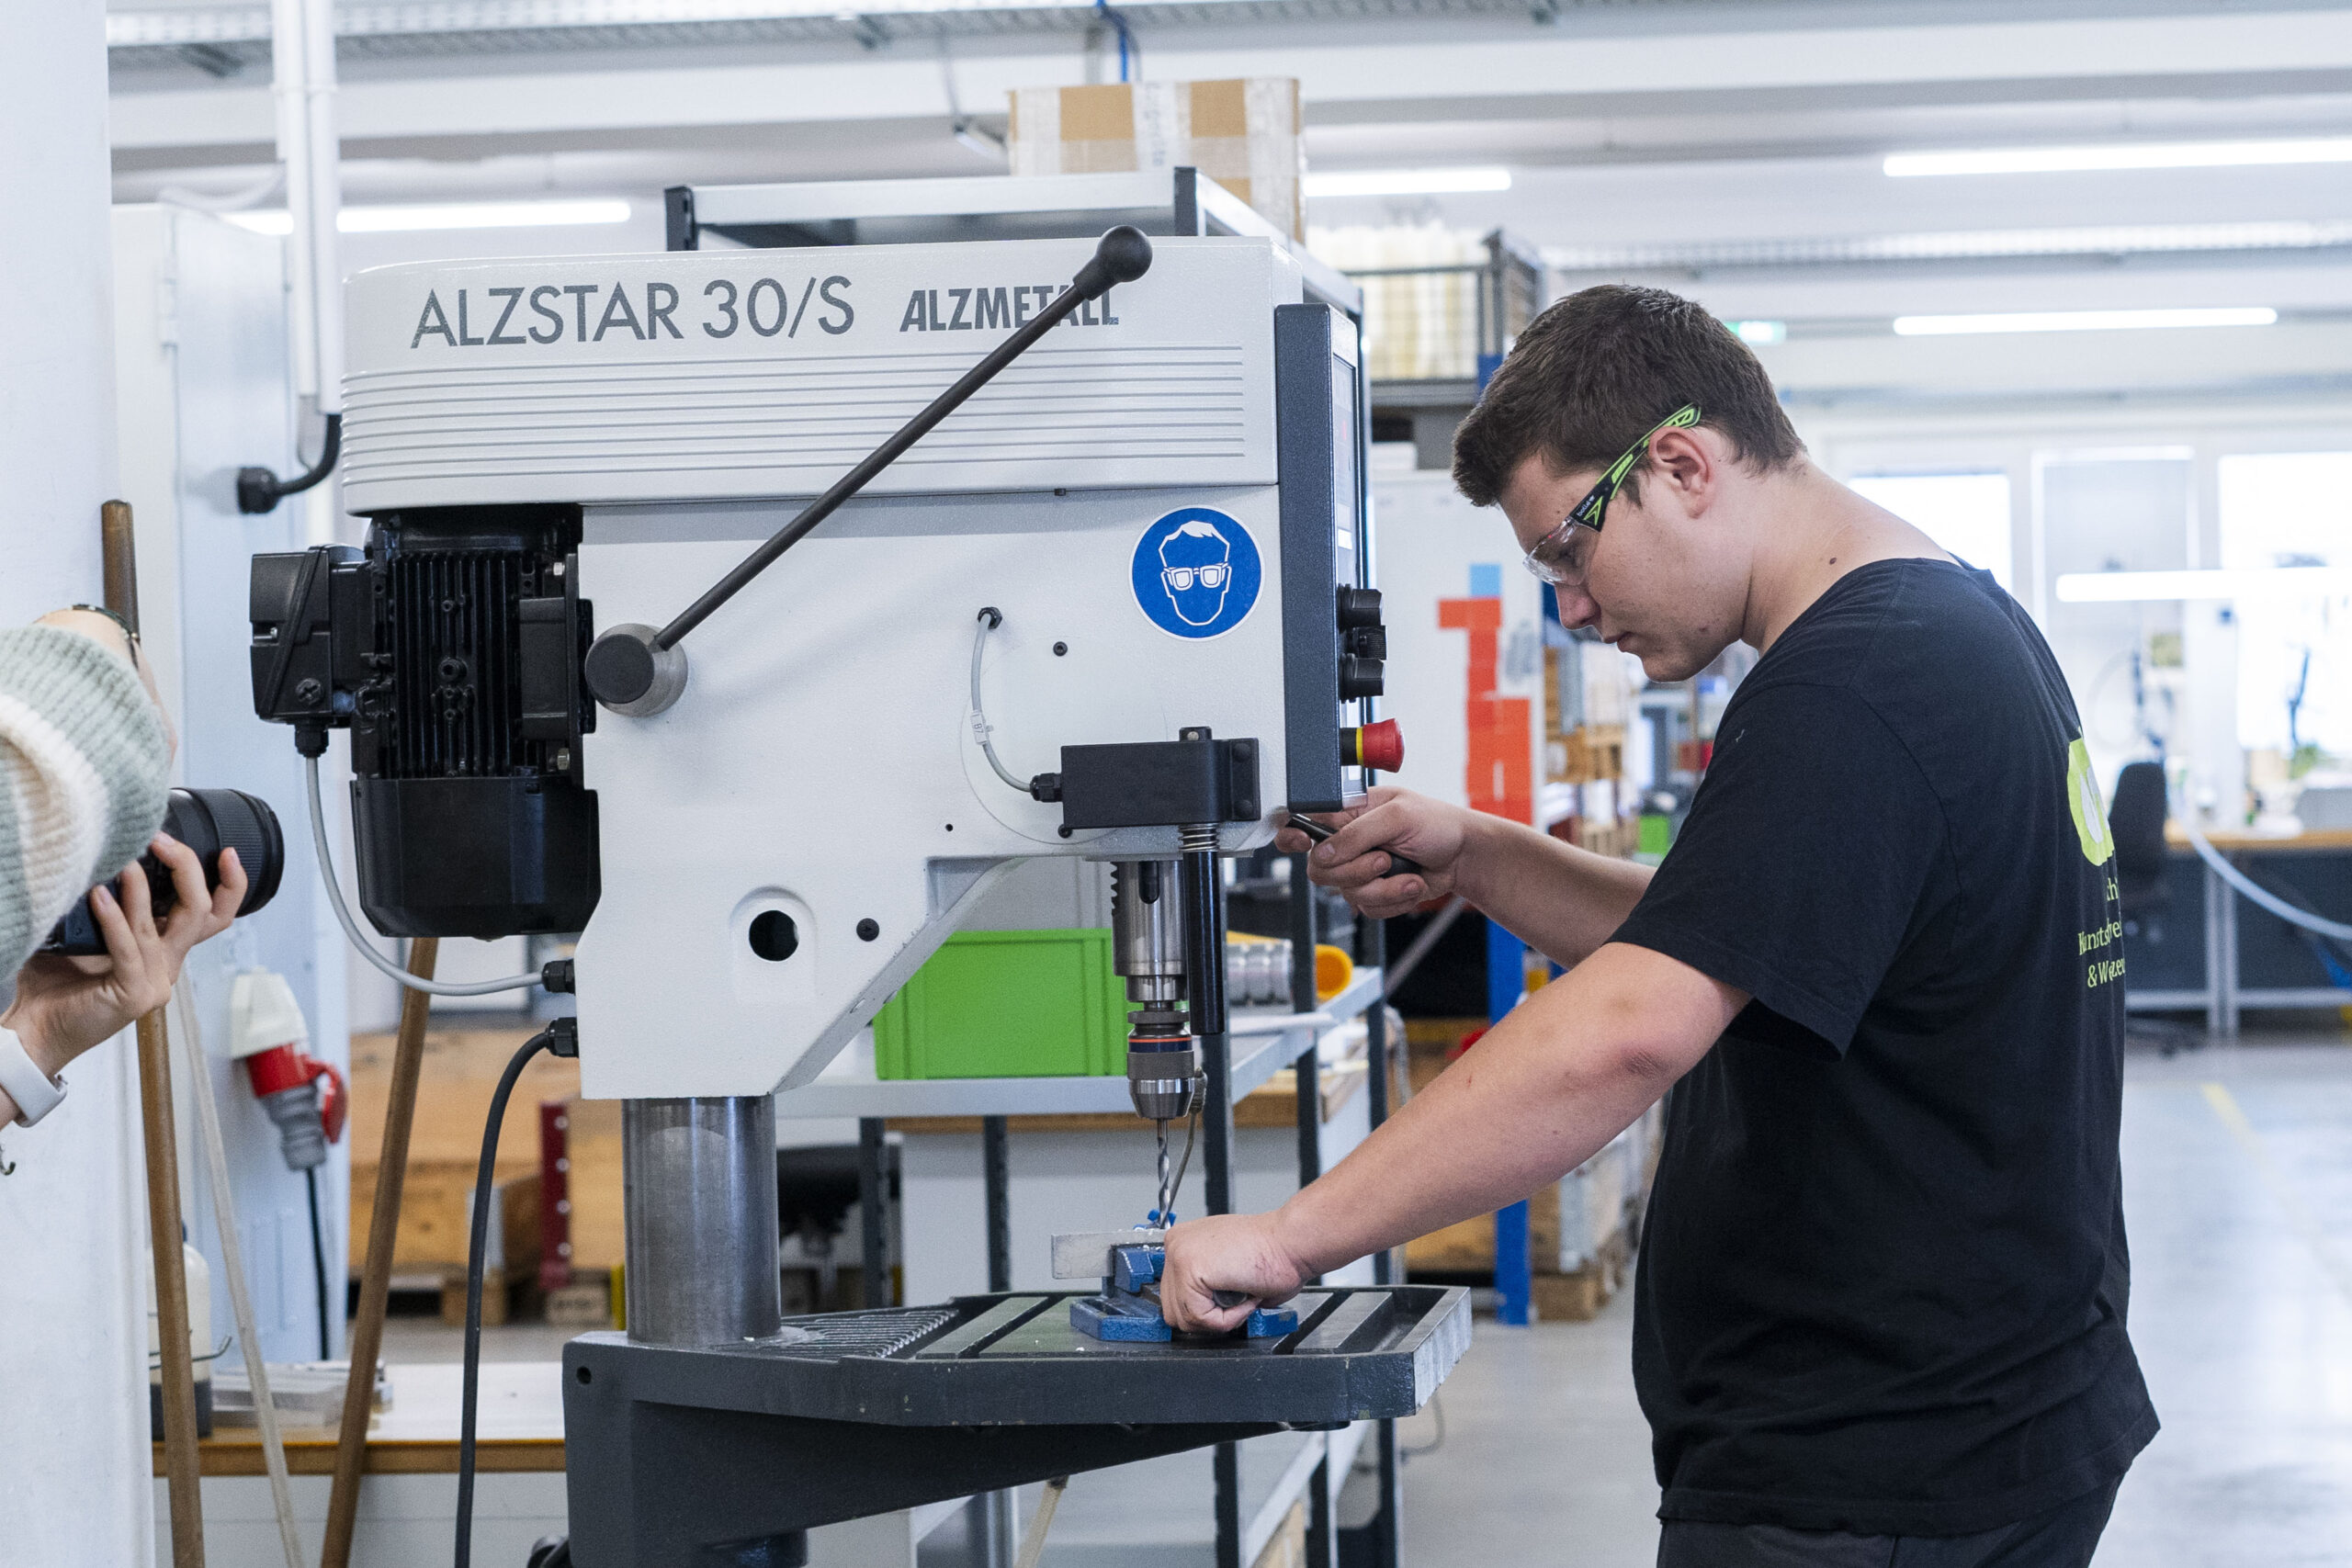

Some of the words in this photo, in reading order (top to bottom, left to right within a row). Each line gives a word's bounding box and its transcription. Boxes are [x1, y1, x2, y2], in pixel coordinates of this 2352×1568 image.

[411, 281, 684, 349] ALZSTAR
[702, 275, 854, 339] 30/S
[2086, 964, 2098, 988] &
